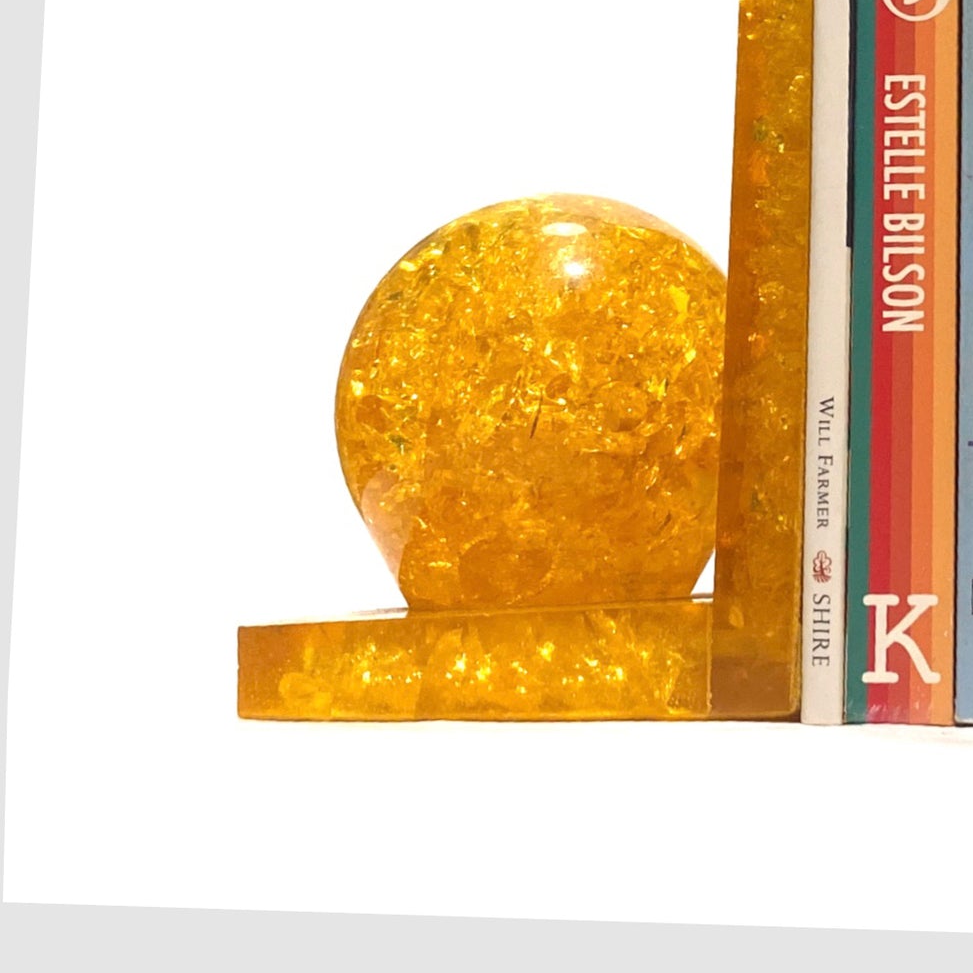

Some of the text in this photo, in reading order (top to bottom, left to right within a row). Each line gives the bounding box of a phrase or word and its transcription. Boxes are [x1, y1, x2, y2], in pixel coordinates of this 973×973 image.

[882, 73, 926, 333] ESTELLE BILSON
[811, 593, 831, 668] SHIRE
[862, 593, 940, 685] K
